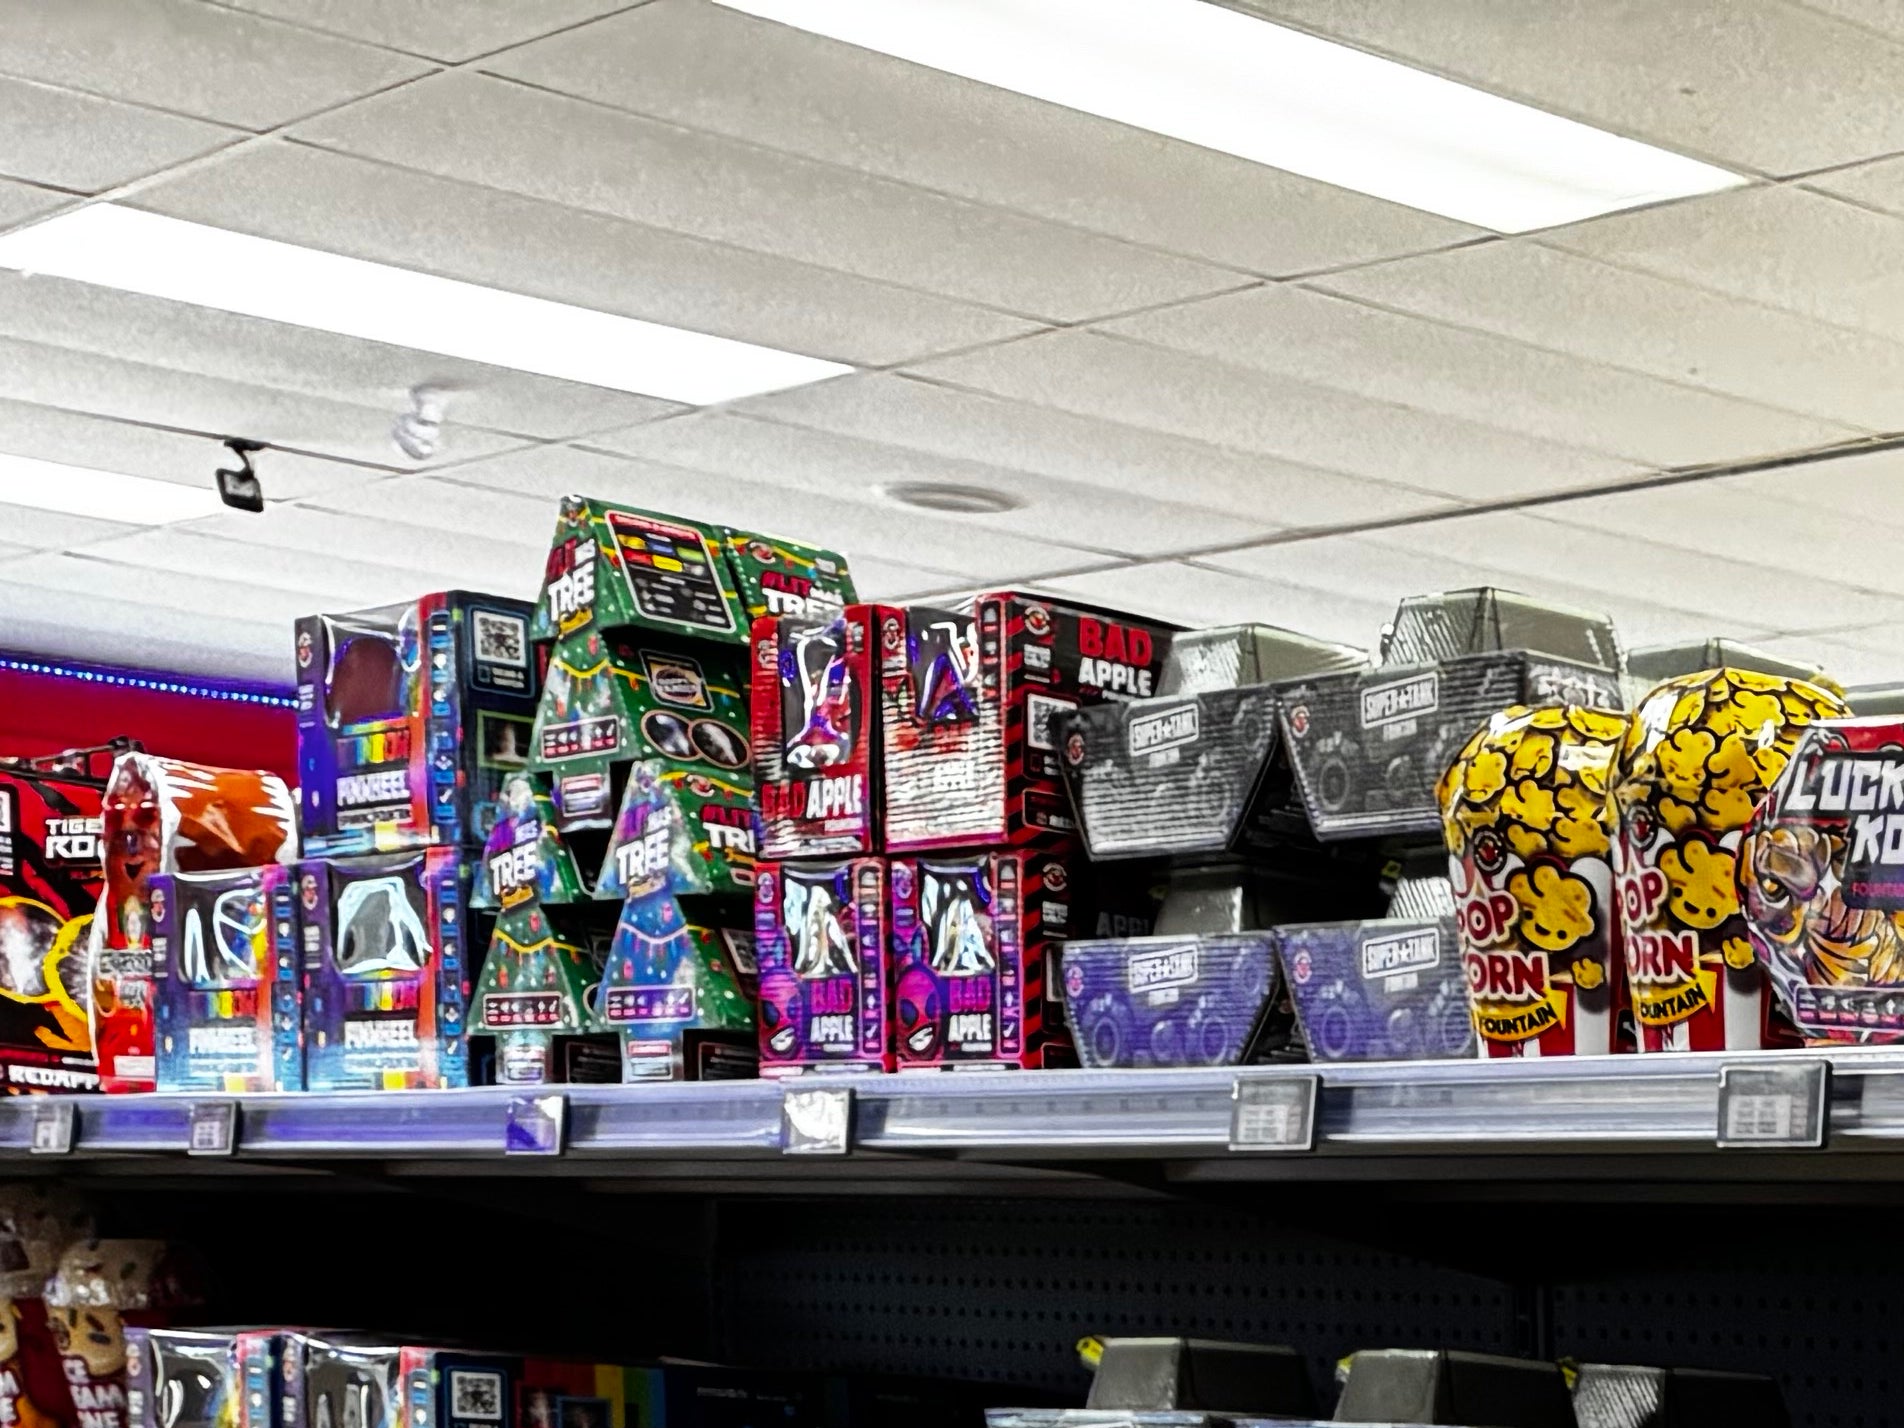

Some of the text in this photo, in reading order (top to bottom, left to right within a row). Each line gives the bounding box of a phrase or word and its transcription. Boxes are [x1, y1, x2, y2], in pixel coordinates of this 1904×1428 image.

[1079, 618, 1152, 658] BAD
[1079, 658, 1152, 697] APPLE
[616, 842, 669, 882] TREE
